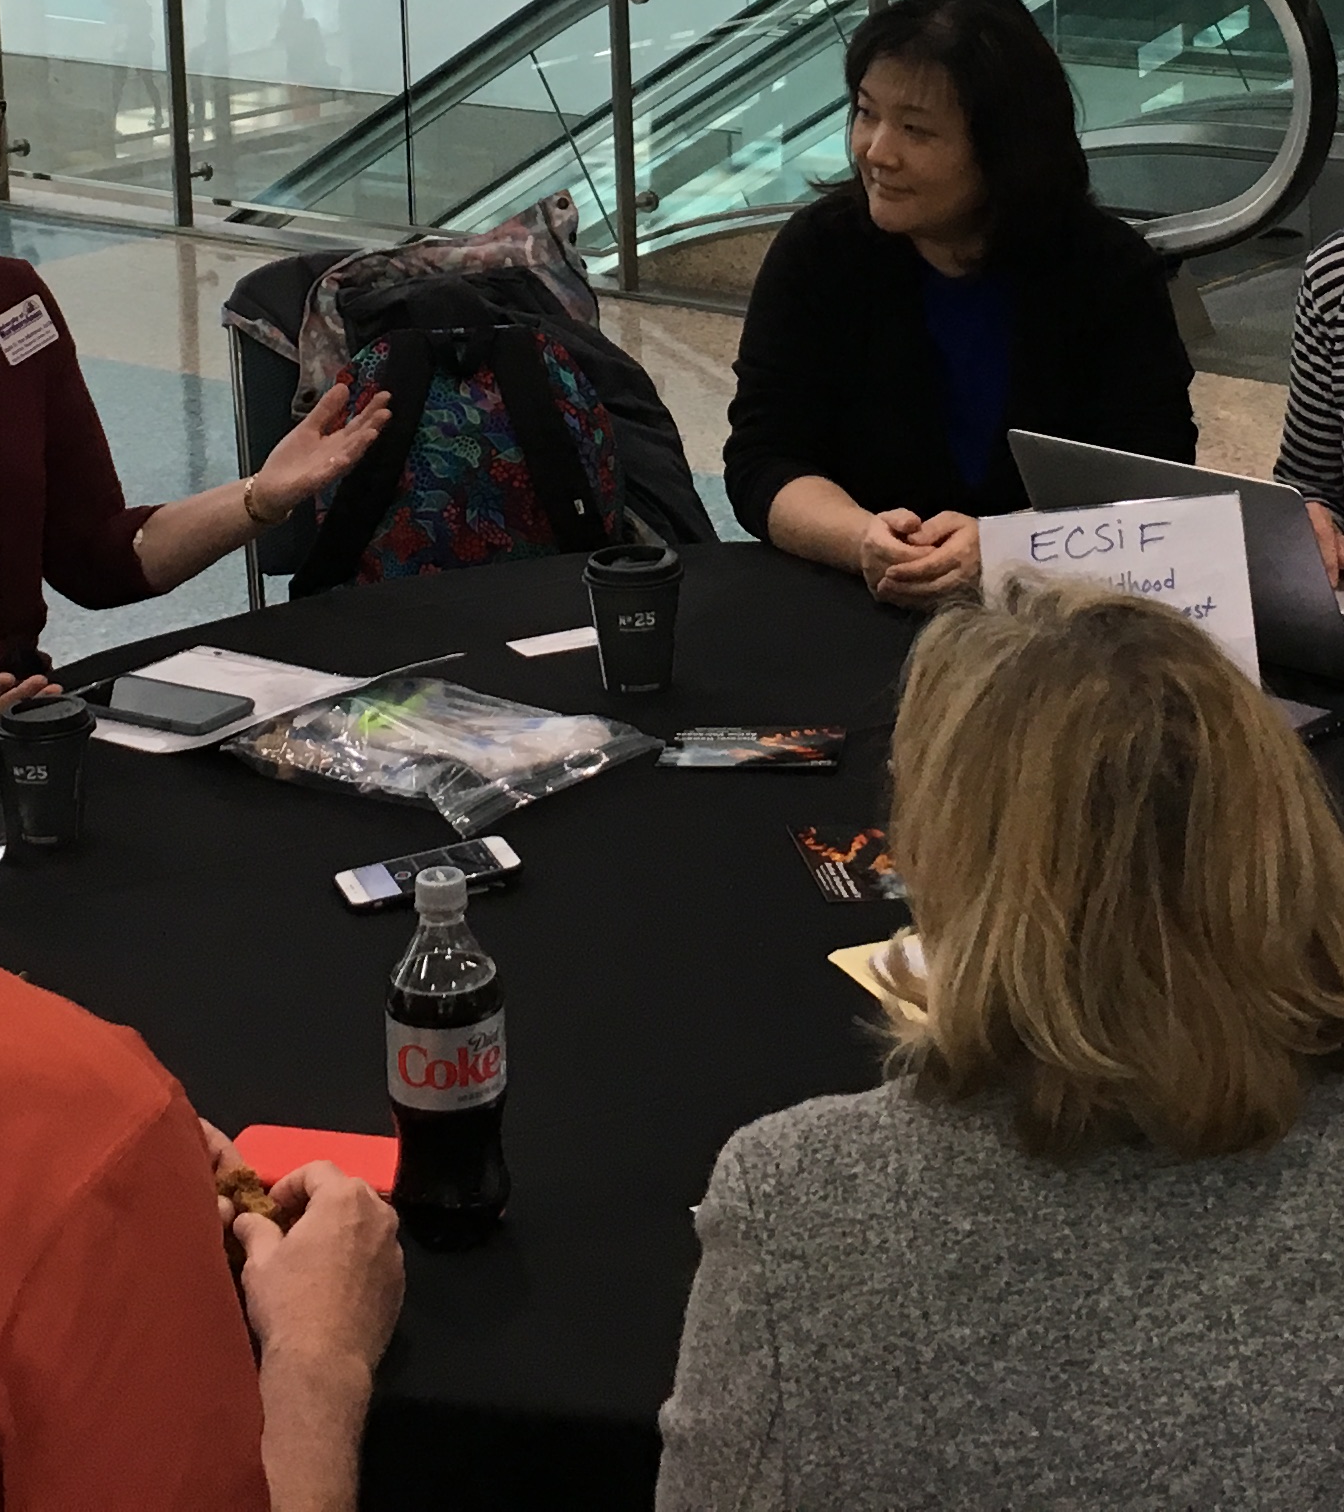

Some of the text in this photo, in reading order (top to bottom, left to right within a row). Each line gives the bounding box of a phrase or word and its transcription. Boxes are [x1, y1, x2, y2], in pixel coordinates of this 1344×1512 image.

[634, 611, 656, 627] 25
[26, 765, 48, 780] 25
[397, 1044, 501, 1089] Coke
